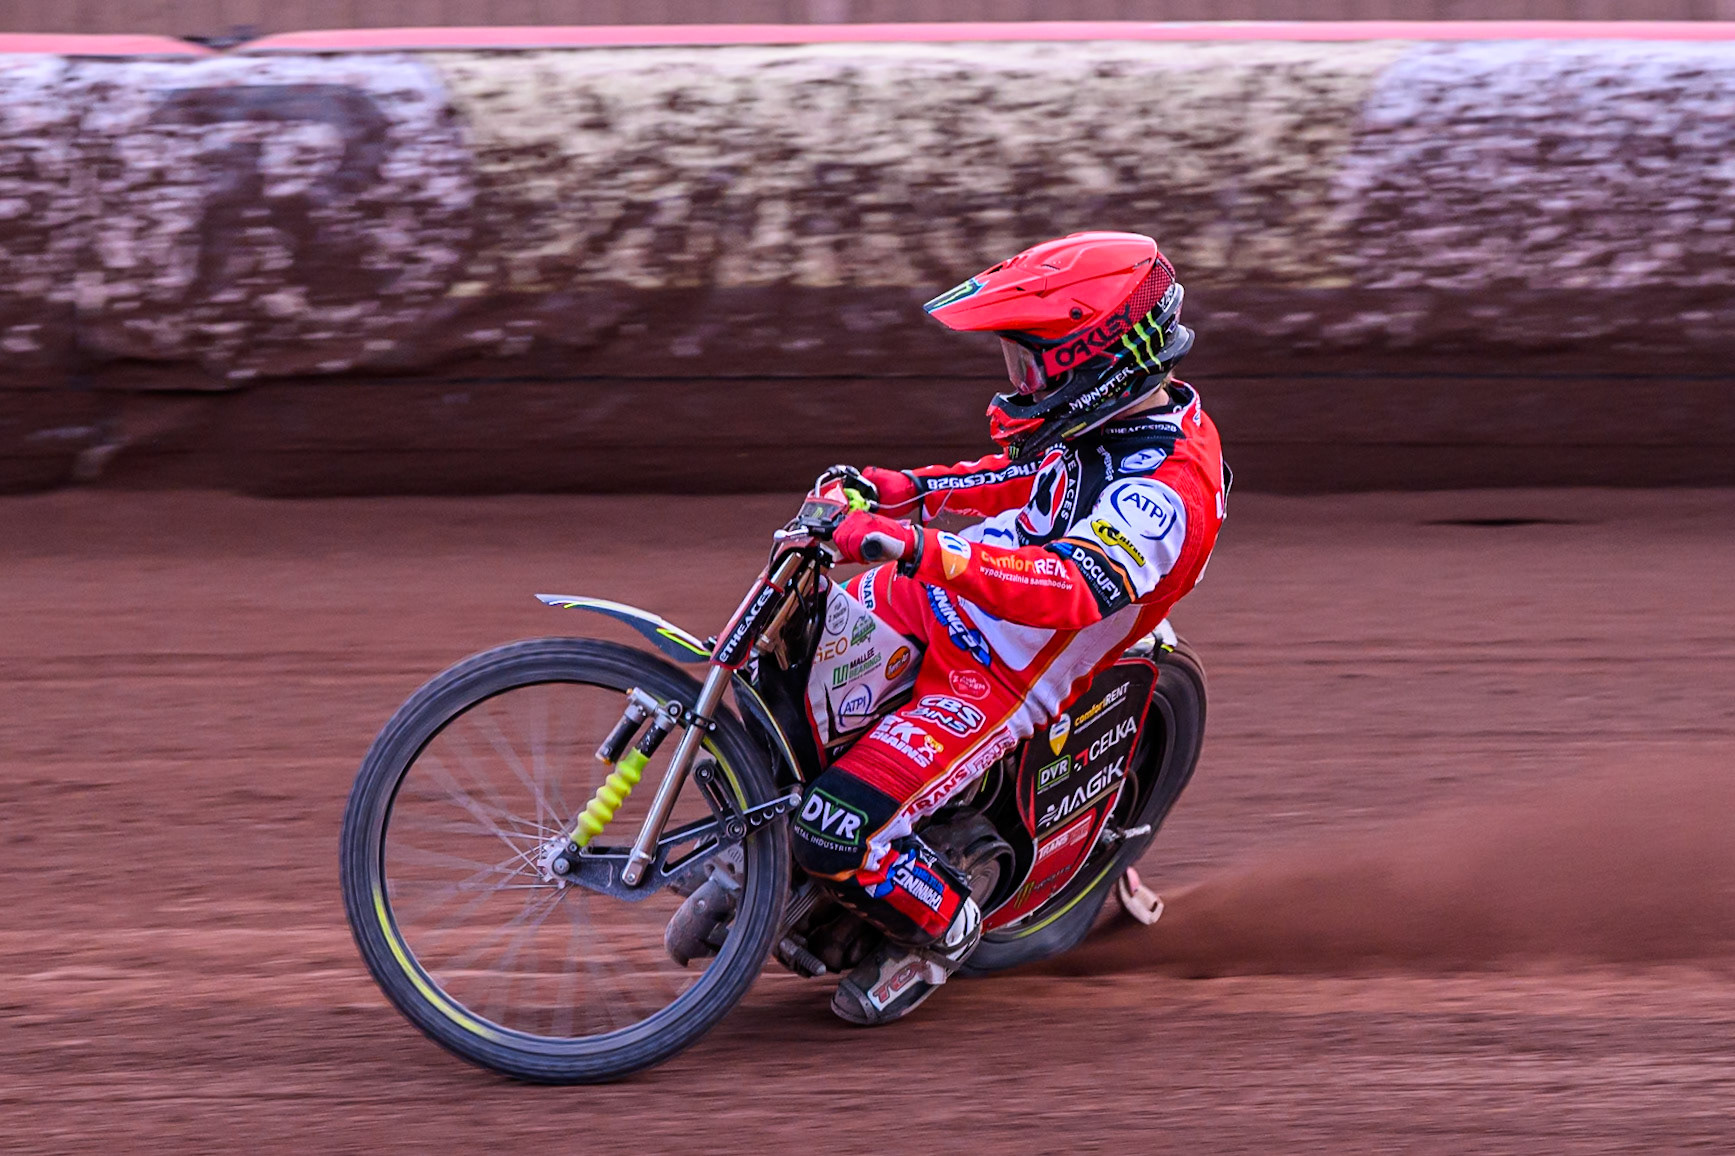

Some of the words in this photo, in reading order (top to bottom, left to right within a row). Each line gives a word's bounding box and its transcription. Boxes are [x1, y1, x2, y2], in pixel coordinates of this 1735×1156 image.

[1055, 304, 1132, 366] OAKLEY
[1069, 367, 1134, 411] MONSTER
[1060, 478, 1076, 520] ACES
[1122, 492, 1167, 528] ATPI
[1072, 547, 1121, 601] DOCUFY
[844, 695, 867, 713] ATPI
[921, 697, 981, 728] CBS
[1089, 716, 1137, 761] CELKA
[901, 767, 969, 818] TRANS
[1040, 759, 1068, 785] DVR
[801, 793, 861, 839] DVR
